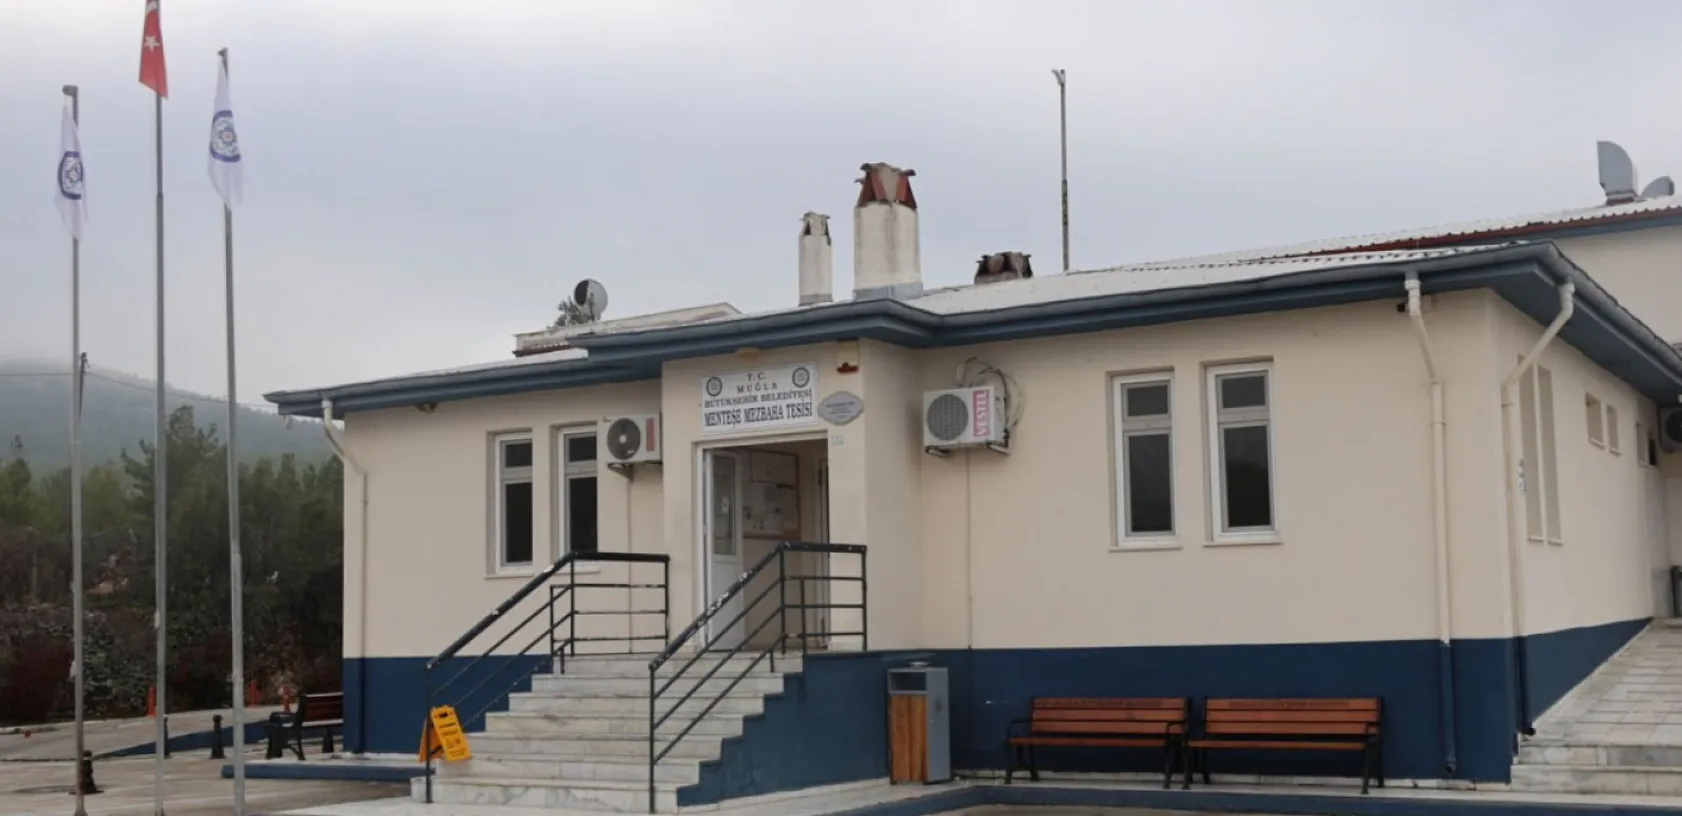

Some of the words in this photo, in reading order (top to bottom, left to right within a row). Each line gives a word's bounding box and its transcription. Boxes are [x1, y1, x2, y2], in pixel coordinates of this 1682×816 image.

[737, 381, 778, 393] MUĞLA
[704, 408, 741, 428] MENTEŞE
[743, 405, 784, 423] MEZBAHA
[975, 391, 988, 435] VESTEL
